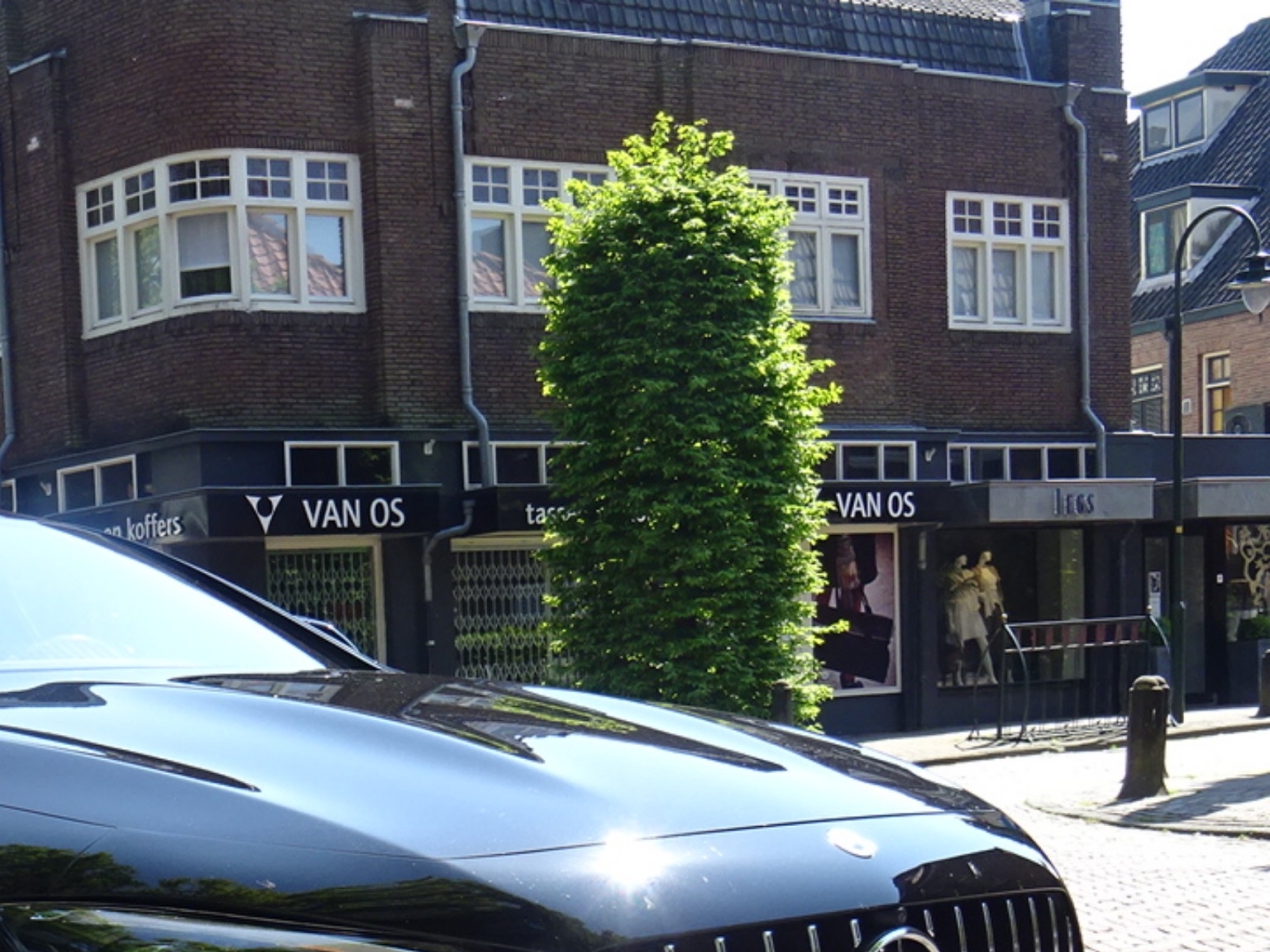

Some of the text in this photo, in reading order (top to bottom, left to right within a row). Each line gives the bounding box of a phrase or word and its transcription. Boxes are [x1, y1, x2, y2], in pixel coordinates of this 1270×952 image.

[302, 498, 405, 528] VAN OS
[836, 491, 916, 518] VAN OS
[126, 512, 183, 541] koffers
